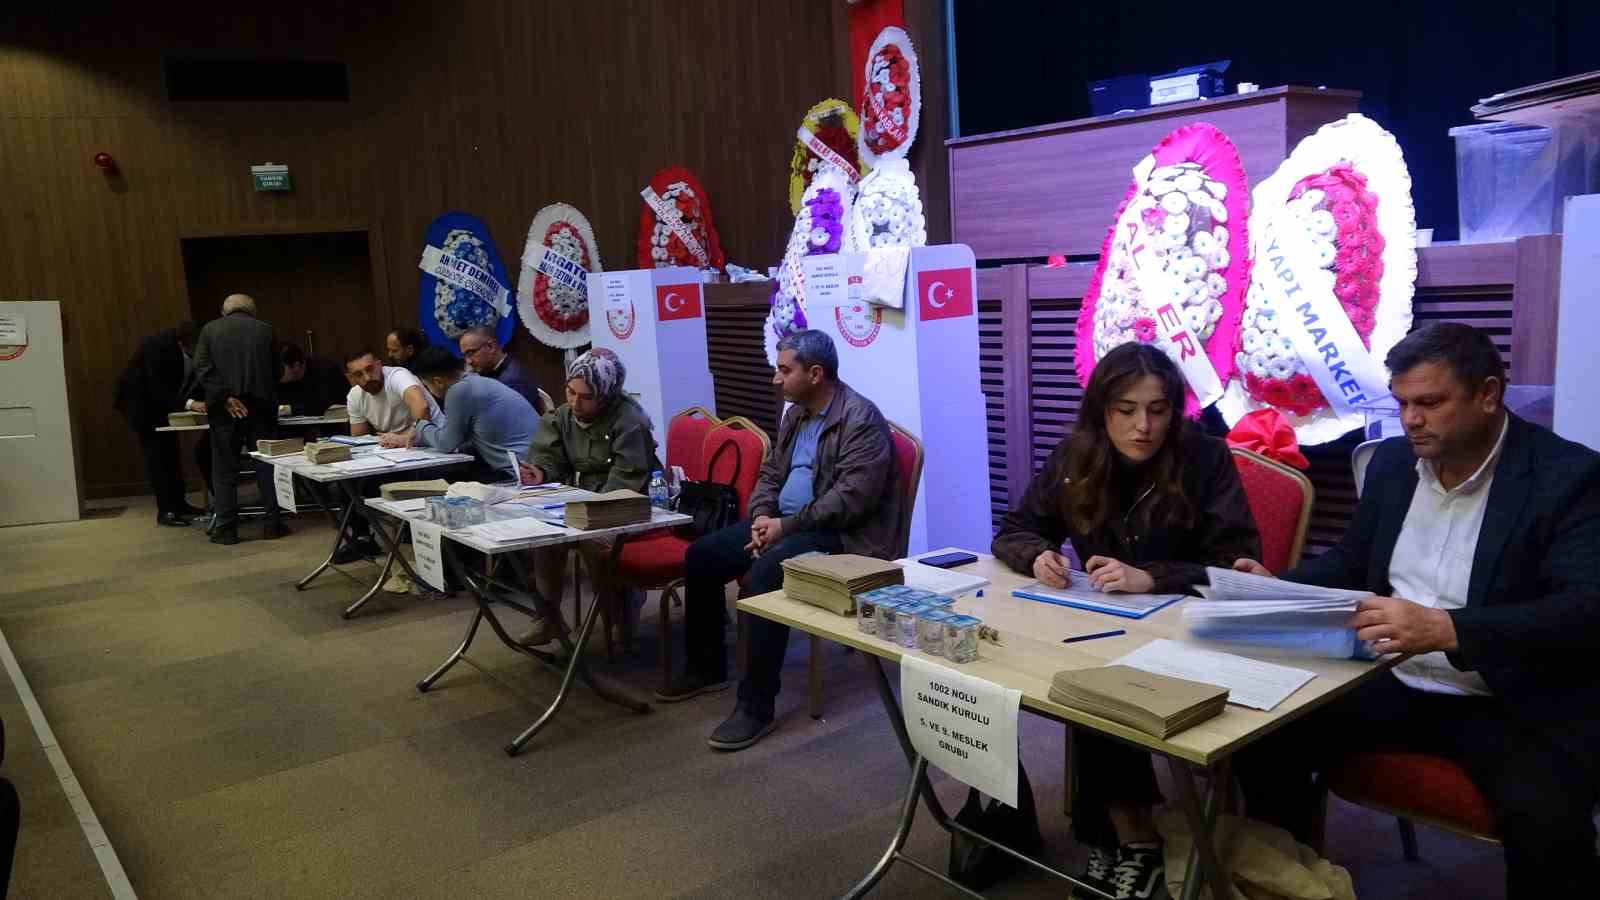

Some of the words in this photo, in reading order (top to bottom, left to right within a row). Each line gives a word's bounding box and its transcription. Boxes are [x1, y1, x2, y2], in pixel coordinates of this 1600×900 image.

[1266, 236, 1303, 299] YAPI
[929, 680, 950, 696] 1002
[952, 689, 977, 705] NOLU
[917, 692, 950, 711] SANDIK
[951, 704, 990, 726] KURULU
[929, 721, 943, 733] VE
[951, 730, 989, 752] MESLEK
[938, 740, 968, 760] GRUBU
